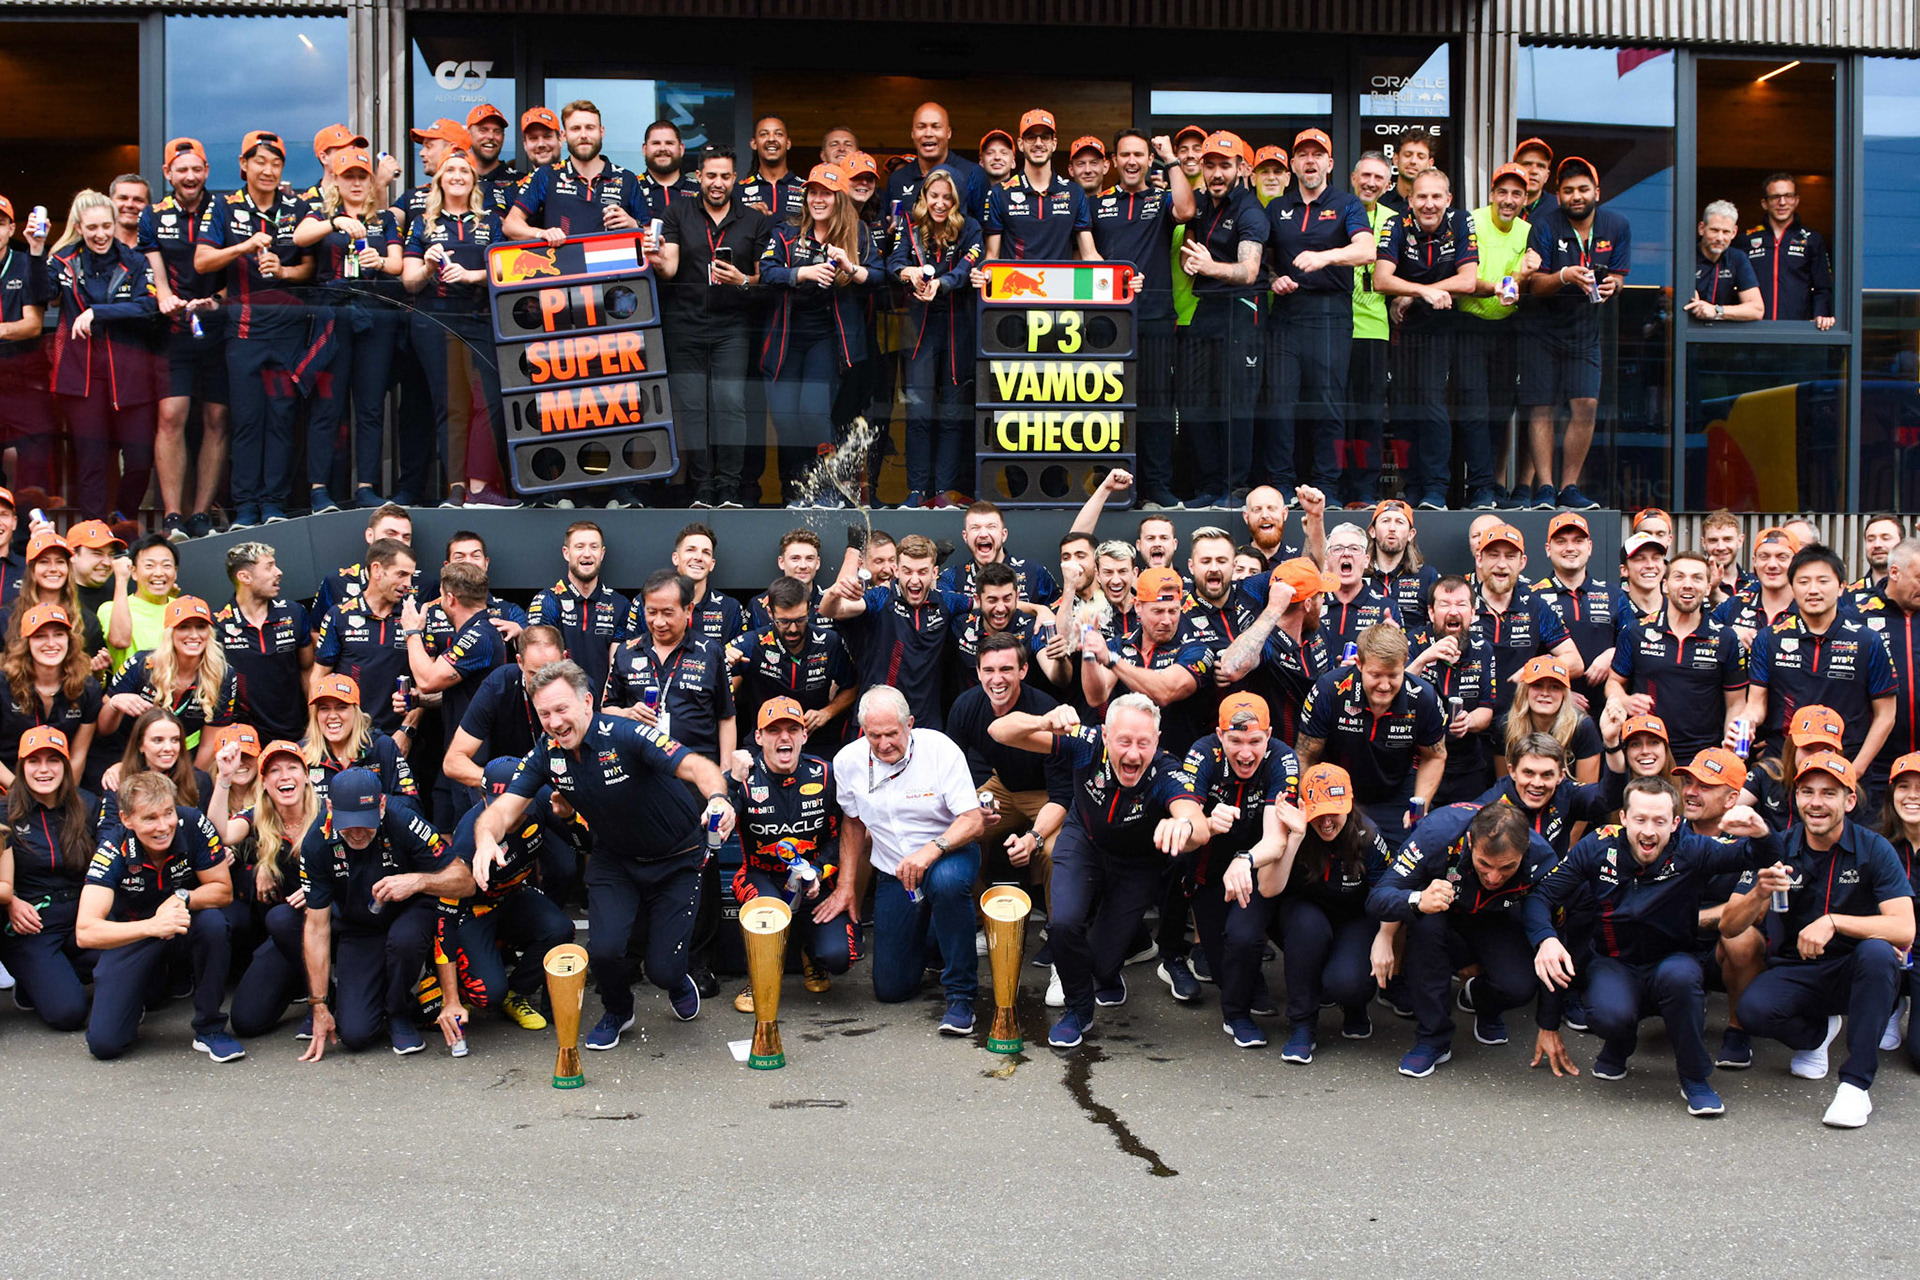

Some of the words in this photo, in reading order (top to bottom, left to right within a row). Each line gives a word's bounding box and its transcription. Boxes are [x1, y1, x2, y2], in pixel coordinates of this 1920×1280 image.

[1371, 76, 1447, 88] ORACLE
[1375, 124, 1440, 136] ORAE
[526, 332, 645, 384] SUPER
[992, 362, 1123, 402] VAMOS
[541, 382, 640, 433] MAX!
[996, 411, 1121, 453] CHECO!
[1399, 591, 1418, 599] BYBIT
[1357, 617, 1377, 625] BYBIT
[1512, 625, 1530, 633] BYBIT
[1695, 648, 1717, 657] BYBIT
[1831, 655, 1855, 664] BYBIT
[1280, 661, 1301, 671] ORACLE
[1775, 660, 1801, 669] ORACLE
[760, 671, 781, 679] ORACLE
[808, 668, 825, 676] BYBIT
[683, 673, 702, 682] BYBIT
[1460, 674, 1480, 682] BYBIT
[1338, 717, 1356, 726] Mobil
[1337, 725, 1363, 733] ORACLE
[1390, 725, 1413, 734] BYBIT
[603, 766, 623, 778] BYBIT
[605, 774, 630, 785] HONDA
[493, 783, 506, 794] 11
[801, 798, 824, 810] BYBIT
[748, 806, 767, 814] Mobil
[801, 809, 825, 817] HONDA
[749, 817, 825, 836] ORACLE
[128, 837, 137, 858] zoom
[996, 1043, 1018, 1051] ROLEX
[755, 1059, 779, 1068] ROLEX
